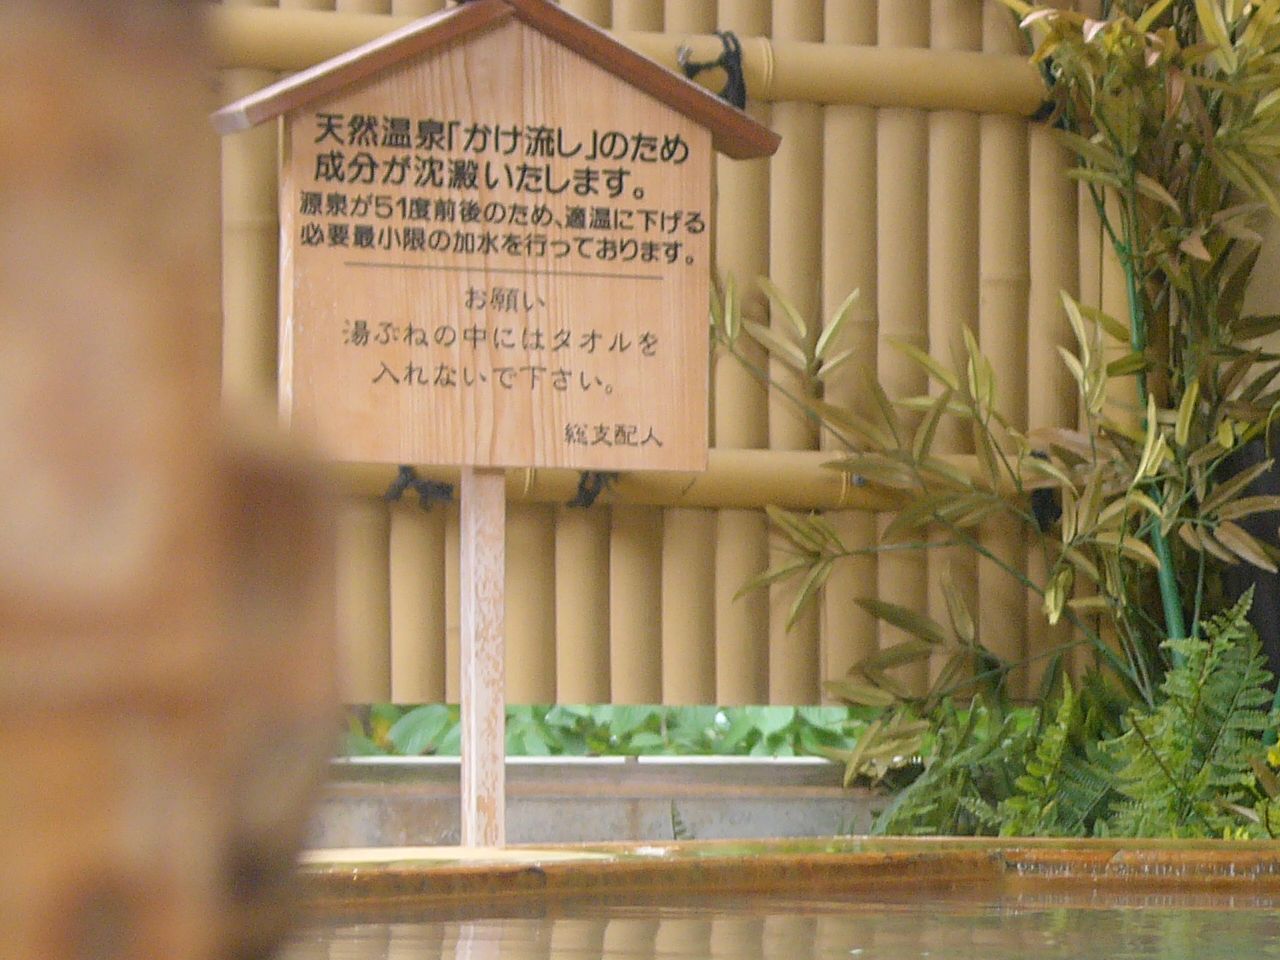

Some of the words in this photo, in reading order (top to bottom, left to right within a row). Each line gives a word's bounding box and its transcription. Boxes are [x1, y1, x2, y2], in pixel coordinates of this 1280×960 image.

[314, 112, 690, 166] 天然温泉「かけ流し」のため
[301, 222, 695, 266] 必要最小限の加水を行っております。
[464, 286, 546, 311] お願い
[342, 319, 659, 357] 湯ぶねの中にはタオルを
[371, 361, 614, 395] 入れないで下さい。
[563, 422, 664, 447] 総支配人
